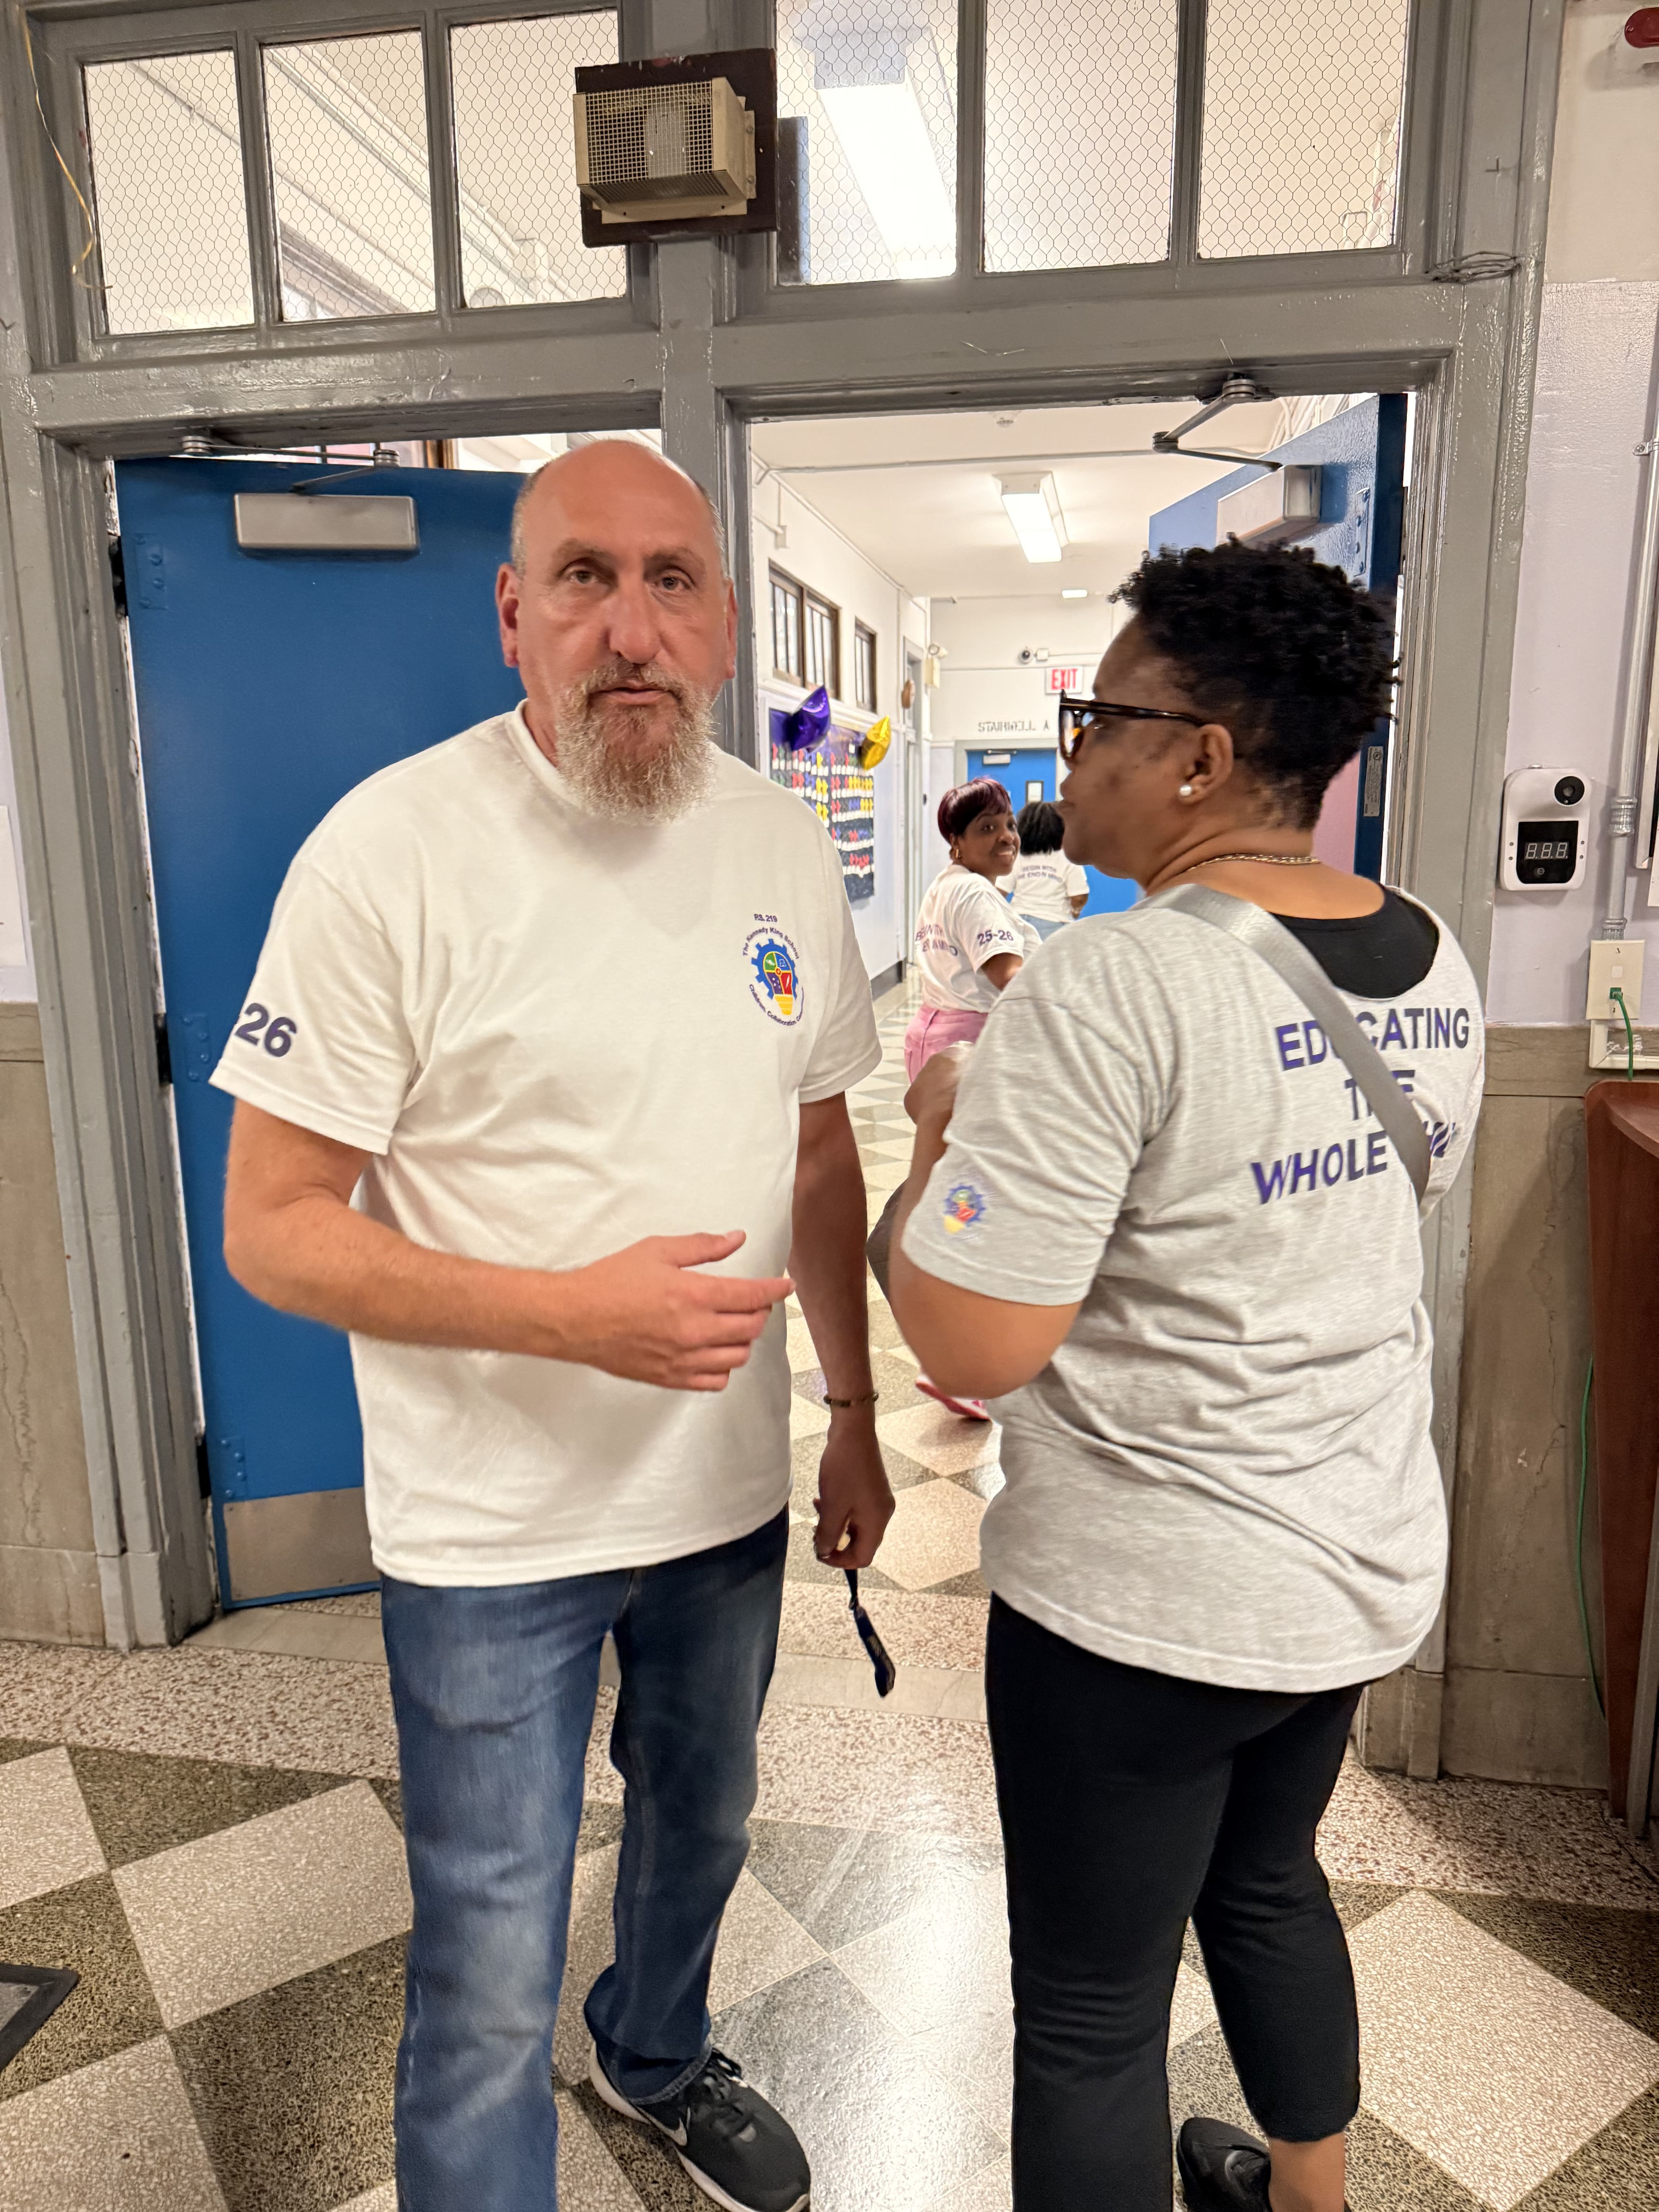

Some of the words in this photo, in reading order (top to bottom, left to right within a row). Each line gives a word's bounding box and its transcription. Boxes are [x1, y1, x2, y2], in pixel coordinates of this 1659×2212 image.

[1051, 668, 1078, 690] EXIT
[978, 721, 1036, 732] STAIRWELL
[1044, 720, 1049, 731] A
[769, 927, 783, 938] King
[784, 935, 799, 959] School
[977, 929, 1013, 946] 25-26
[1252, 1130, 1388, 1205] WHOLE
